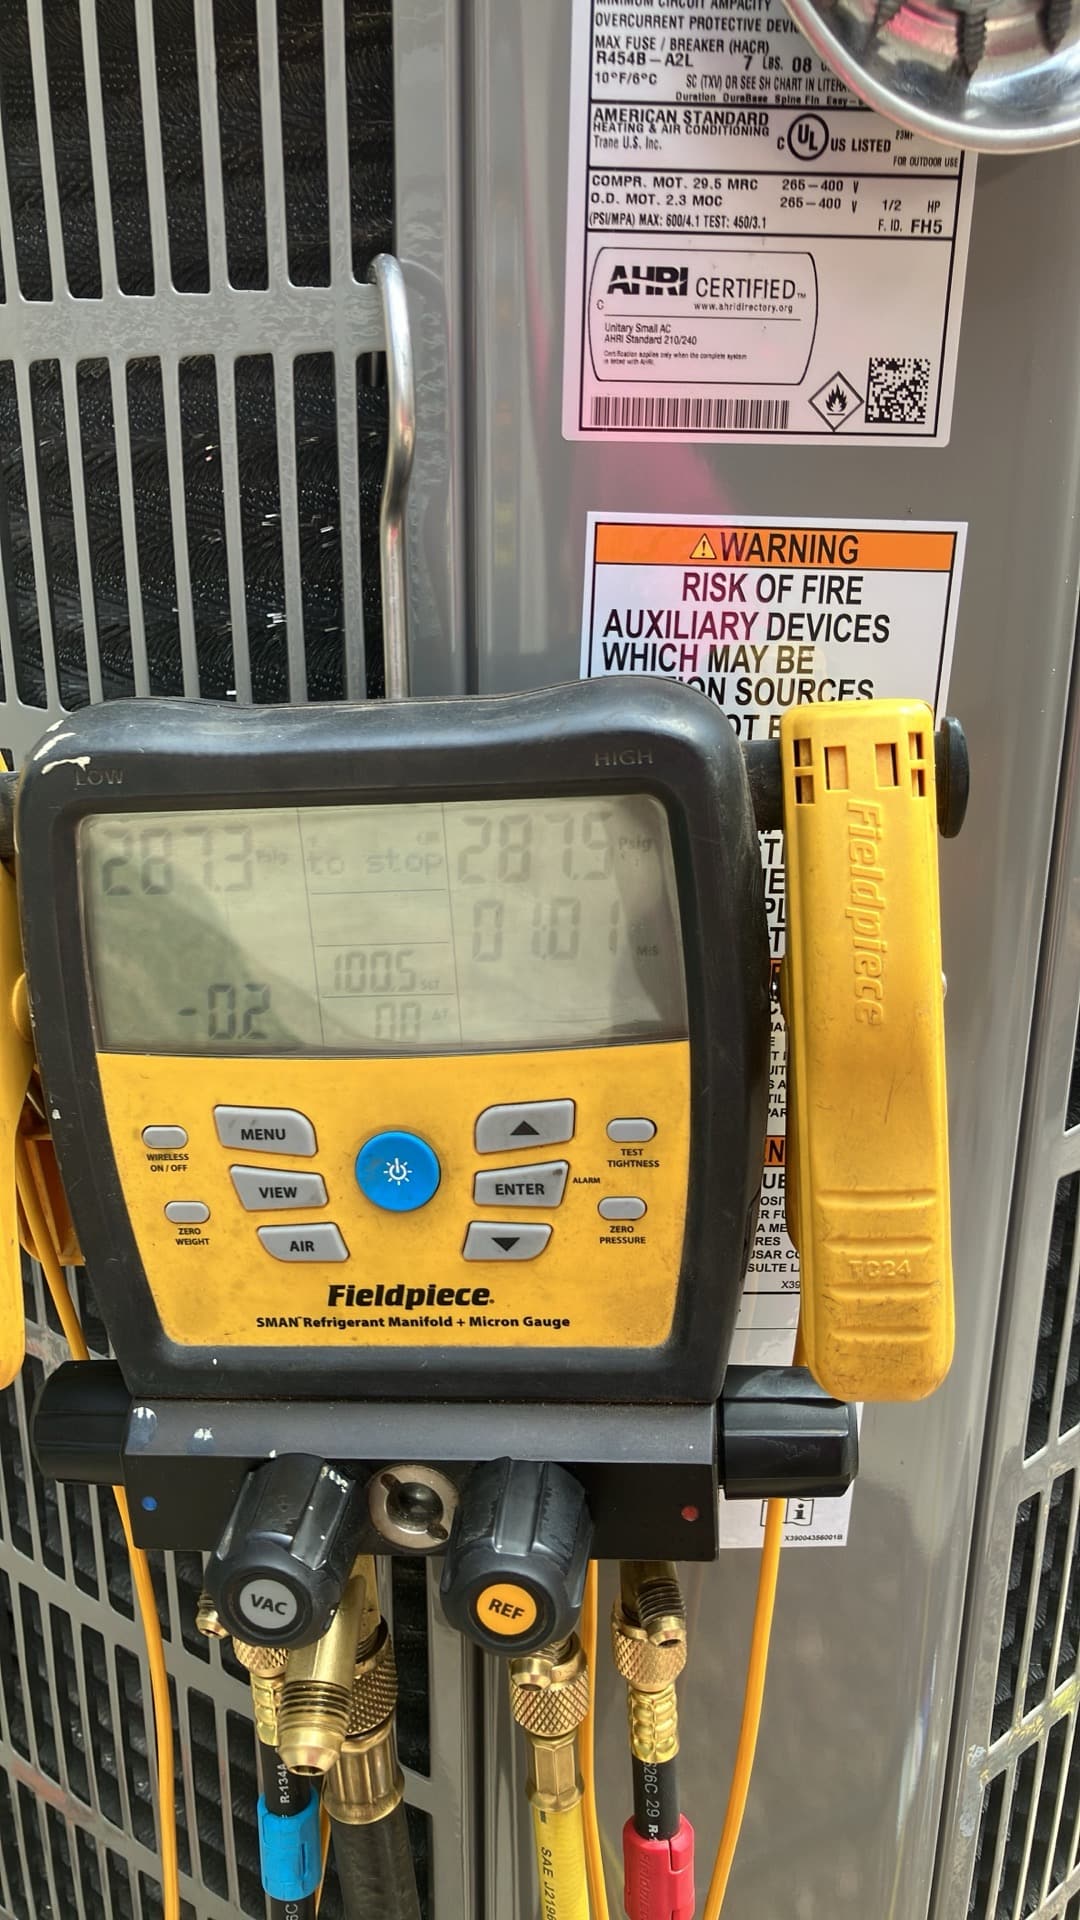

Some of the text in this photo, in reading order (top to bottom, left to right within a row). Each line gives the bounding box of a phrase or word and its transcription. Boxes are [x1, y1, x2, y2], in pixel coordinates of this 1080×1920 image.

[595, 13, 684, 29] OVERCURRENT
[690, 16, 762, 31] PROTECTIVE
[595, 35, 621, 50] MAX
[626, 36, 656, 50] FUSE
[670, 39, 724, 53] BREAKER
[729, 41, 770, 55] (HACR)
[744, 55, 753, 71] 7
[763, 56, 784, 71] LBS.
[792, 57, 813, 73] 08
[686, 74, 698, 88] SC
[701, 74, 723, 92] (TXV)
[725, 75, 739, 90] OR
[740, 76, 757, 91] SEE
[759, 76, 771, 91] SH
[774, 77, 805, 92] CHART
[805, 78, 815, 92] IN
[676, 92, 716, 102] Duration
[594, 108, 769, 126] AMERICAN STANDARD
[593, 122, 770, 137] HEATING & AIR CONDITIONING
[594, 134, 663, 151] Trane U.S. Inc.
[797, 124, 818, 151] UL
[830, 138, 846, 152] US
[851, 139, 892, 153] LISTED
[893, 155, 958, 168] FOR OUTDOOR USE
[592, 175, 647, 188] COMPR.
[653, 176, 688, 189] MOT.
[693, 177, 722, 190] 29.5
[727, 178, 759, 191] MRC
[853, 181, 859, 195] V
[591, 192, 620, 205] O.D.
[626, 193, 661, 206] MOT.
[666, 194, 687, 206] 2.3
[692, 195, 723, 207] MOC
[851, 201, 858, 214] V
[882, 200, 902, 212] 1/2
[927, 200, 941, 213] HP
[589, 211, 636, 228] (PSI/MPA)
[639, 213, 663, 227] MAX:
[666, 214, 699, 228] 600/4.1
[704, 215, 730, 228] TEST:
[733, 216, 767, 229] 450/3.1
[911, 219, 943, 234] FH5
[607, 265, 689, 297] AHRI
[696, 277, 796, 300] CERTIFIED
[694, 302, 793, 314] www.ahridirectory.org
[605, 322, 672, 335] Unitary Small AC
[604, 334, 698, 346] AHRI Standard 210/240
[720, 532, 860, 564] WARNING
[682, 572, 864, 606] RISK OF FIRE
[603, 608, 890, 643] AUXILIARY DEVICES
[603, 641, 815, 675] WHICH MAY BE
[594, 751, 654, 767] HIGH
[75, 769, 124, 786] LOW
[366, 848, 445, 877] stop
[844, 799, 888, 1027] Fieldpiece
[240, 1128, 287, 1141] MENU
[146, 1153, 189, 1162] WIRELESS
[620, 1148, 644, 1157] TEST
[150, 1164, 164, 1173] ON
[170, 1164, 188, 1173] OFF
[606, 1159, 660, 1168] TIGHTNESS
[572, 1176, 601, 1185] ALARM
[258, 1186, 298, 1199] VIEW
[494, 1183, 545, 1196] ENTER
[178, 1227, 202, 1236] ZERO
[609, 1225, 635, 1234] ZERO
[175, 1237, 210, 1247] WEIGHT
[289, 1239, 315, 1252] AIR
[599, 1236, 647, 1245] PRESSURE
[327, 1283, 495, 1310] Fieldpiece
[303, 1316, 385, 1329] Refrigerant
[388, 1315, 453, 1328] Manifold
[456, 1317, 465, 1327] +
[469, 1316, 519, 1328] Micron
[522, 1316, 570, 1329] Gauge
[249, 1593, 288, 1616] VAC
[487, 1597, 526, 1621] REF
[541, 1847, 554, 1878] SAE
